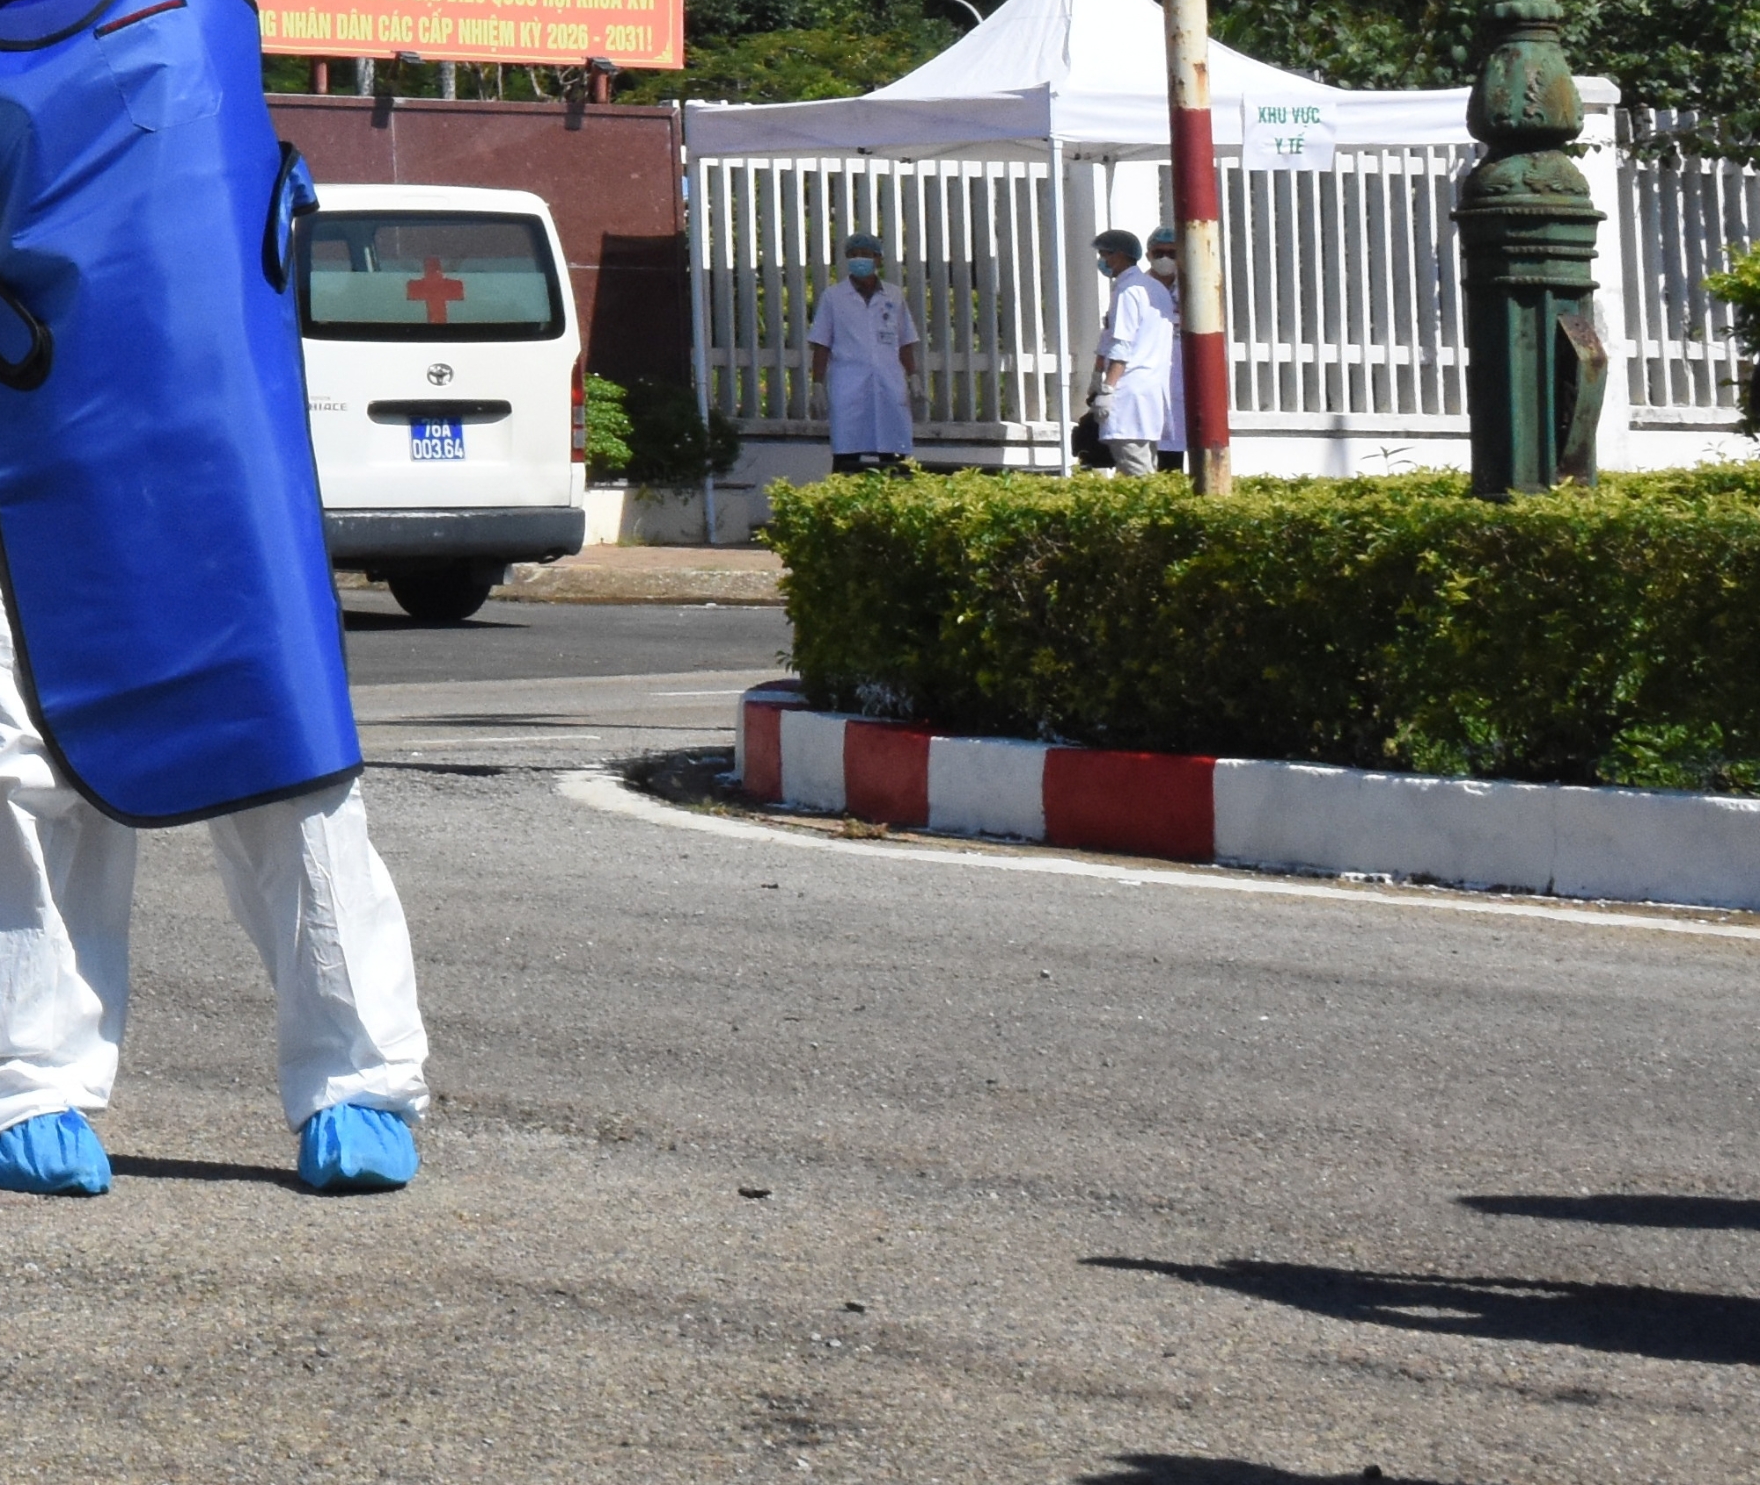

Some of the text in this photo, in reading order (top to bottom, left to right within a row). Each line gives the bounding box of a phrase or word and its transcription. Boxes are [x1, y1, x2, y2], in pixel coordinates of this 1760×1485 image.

[282, 6, 332, 40] NHÂN
[336, 8, 373, 41] DÂN
[378, 9, 413, 42] CÁC
[418, 8, 453, 44] CẤP
[458, 14, 515, 52] NHIỆM
[520, 16, 542, 48] KỲ
[547, 23, 588, 50] 2026
[605, 25, 653, 52] 2031!
[1258, 105, 1320, 128] KHU VỰC
[1274, 131, 1305, 155] Y TẾ
[421, 418, 451, 437] 76A
